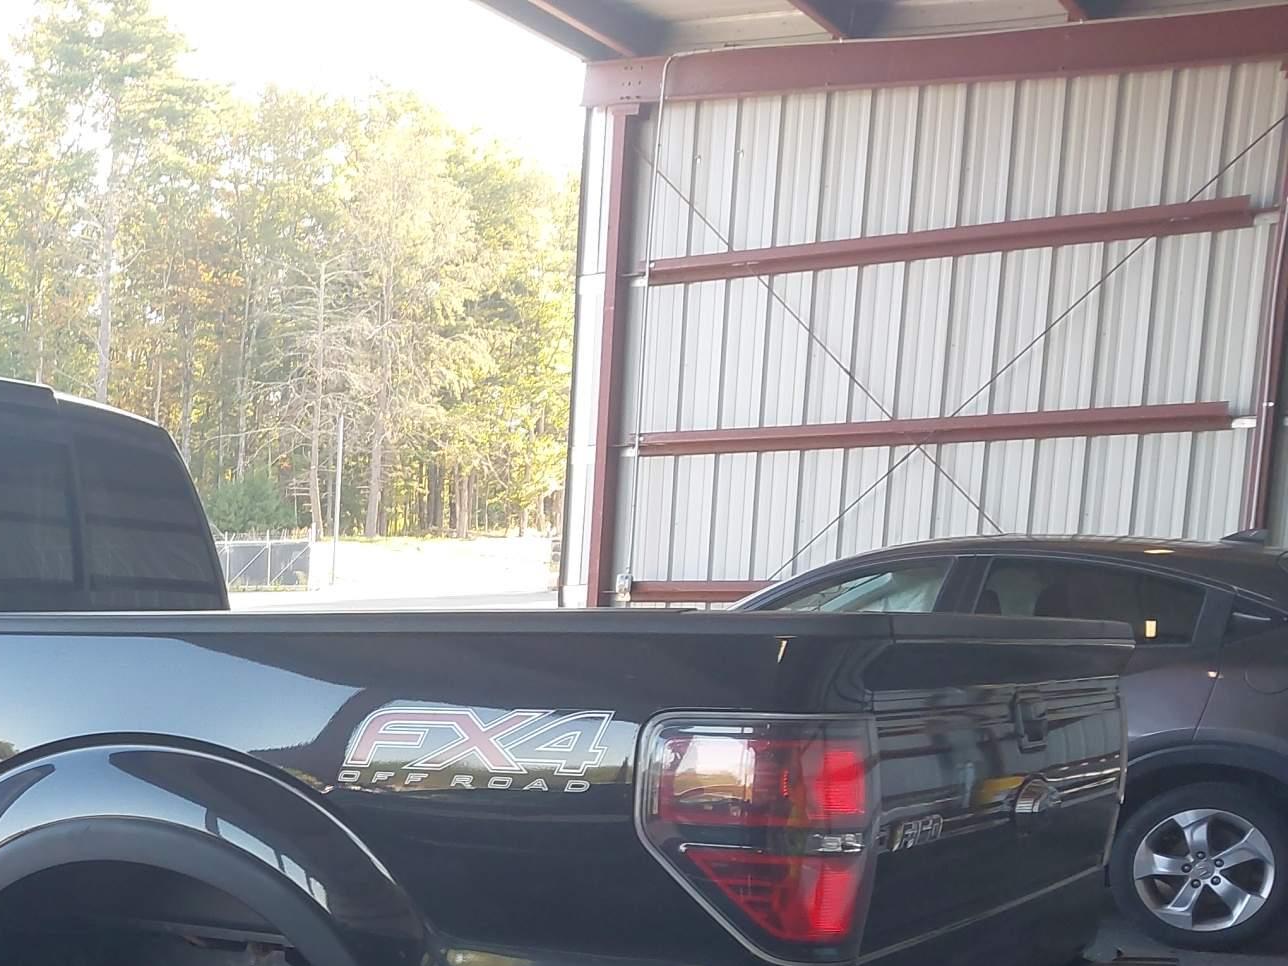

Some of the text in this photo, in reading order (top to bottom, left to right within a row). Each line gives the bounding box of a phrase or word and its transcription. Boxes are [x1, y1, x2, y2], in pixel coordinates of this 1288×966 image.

[342, 707, 615, 776] FX4
[337, 769, 591, 793] OFF ROAD
